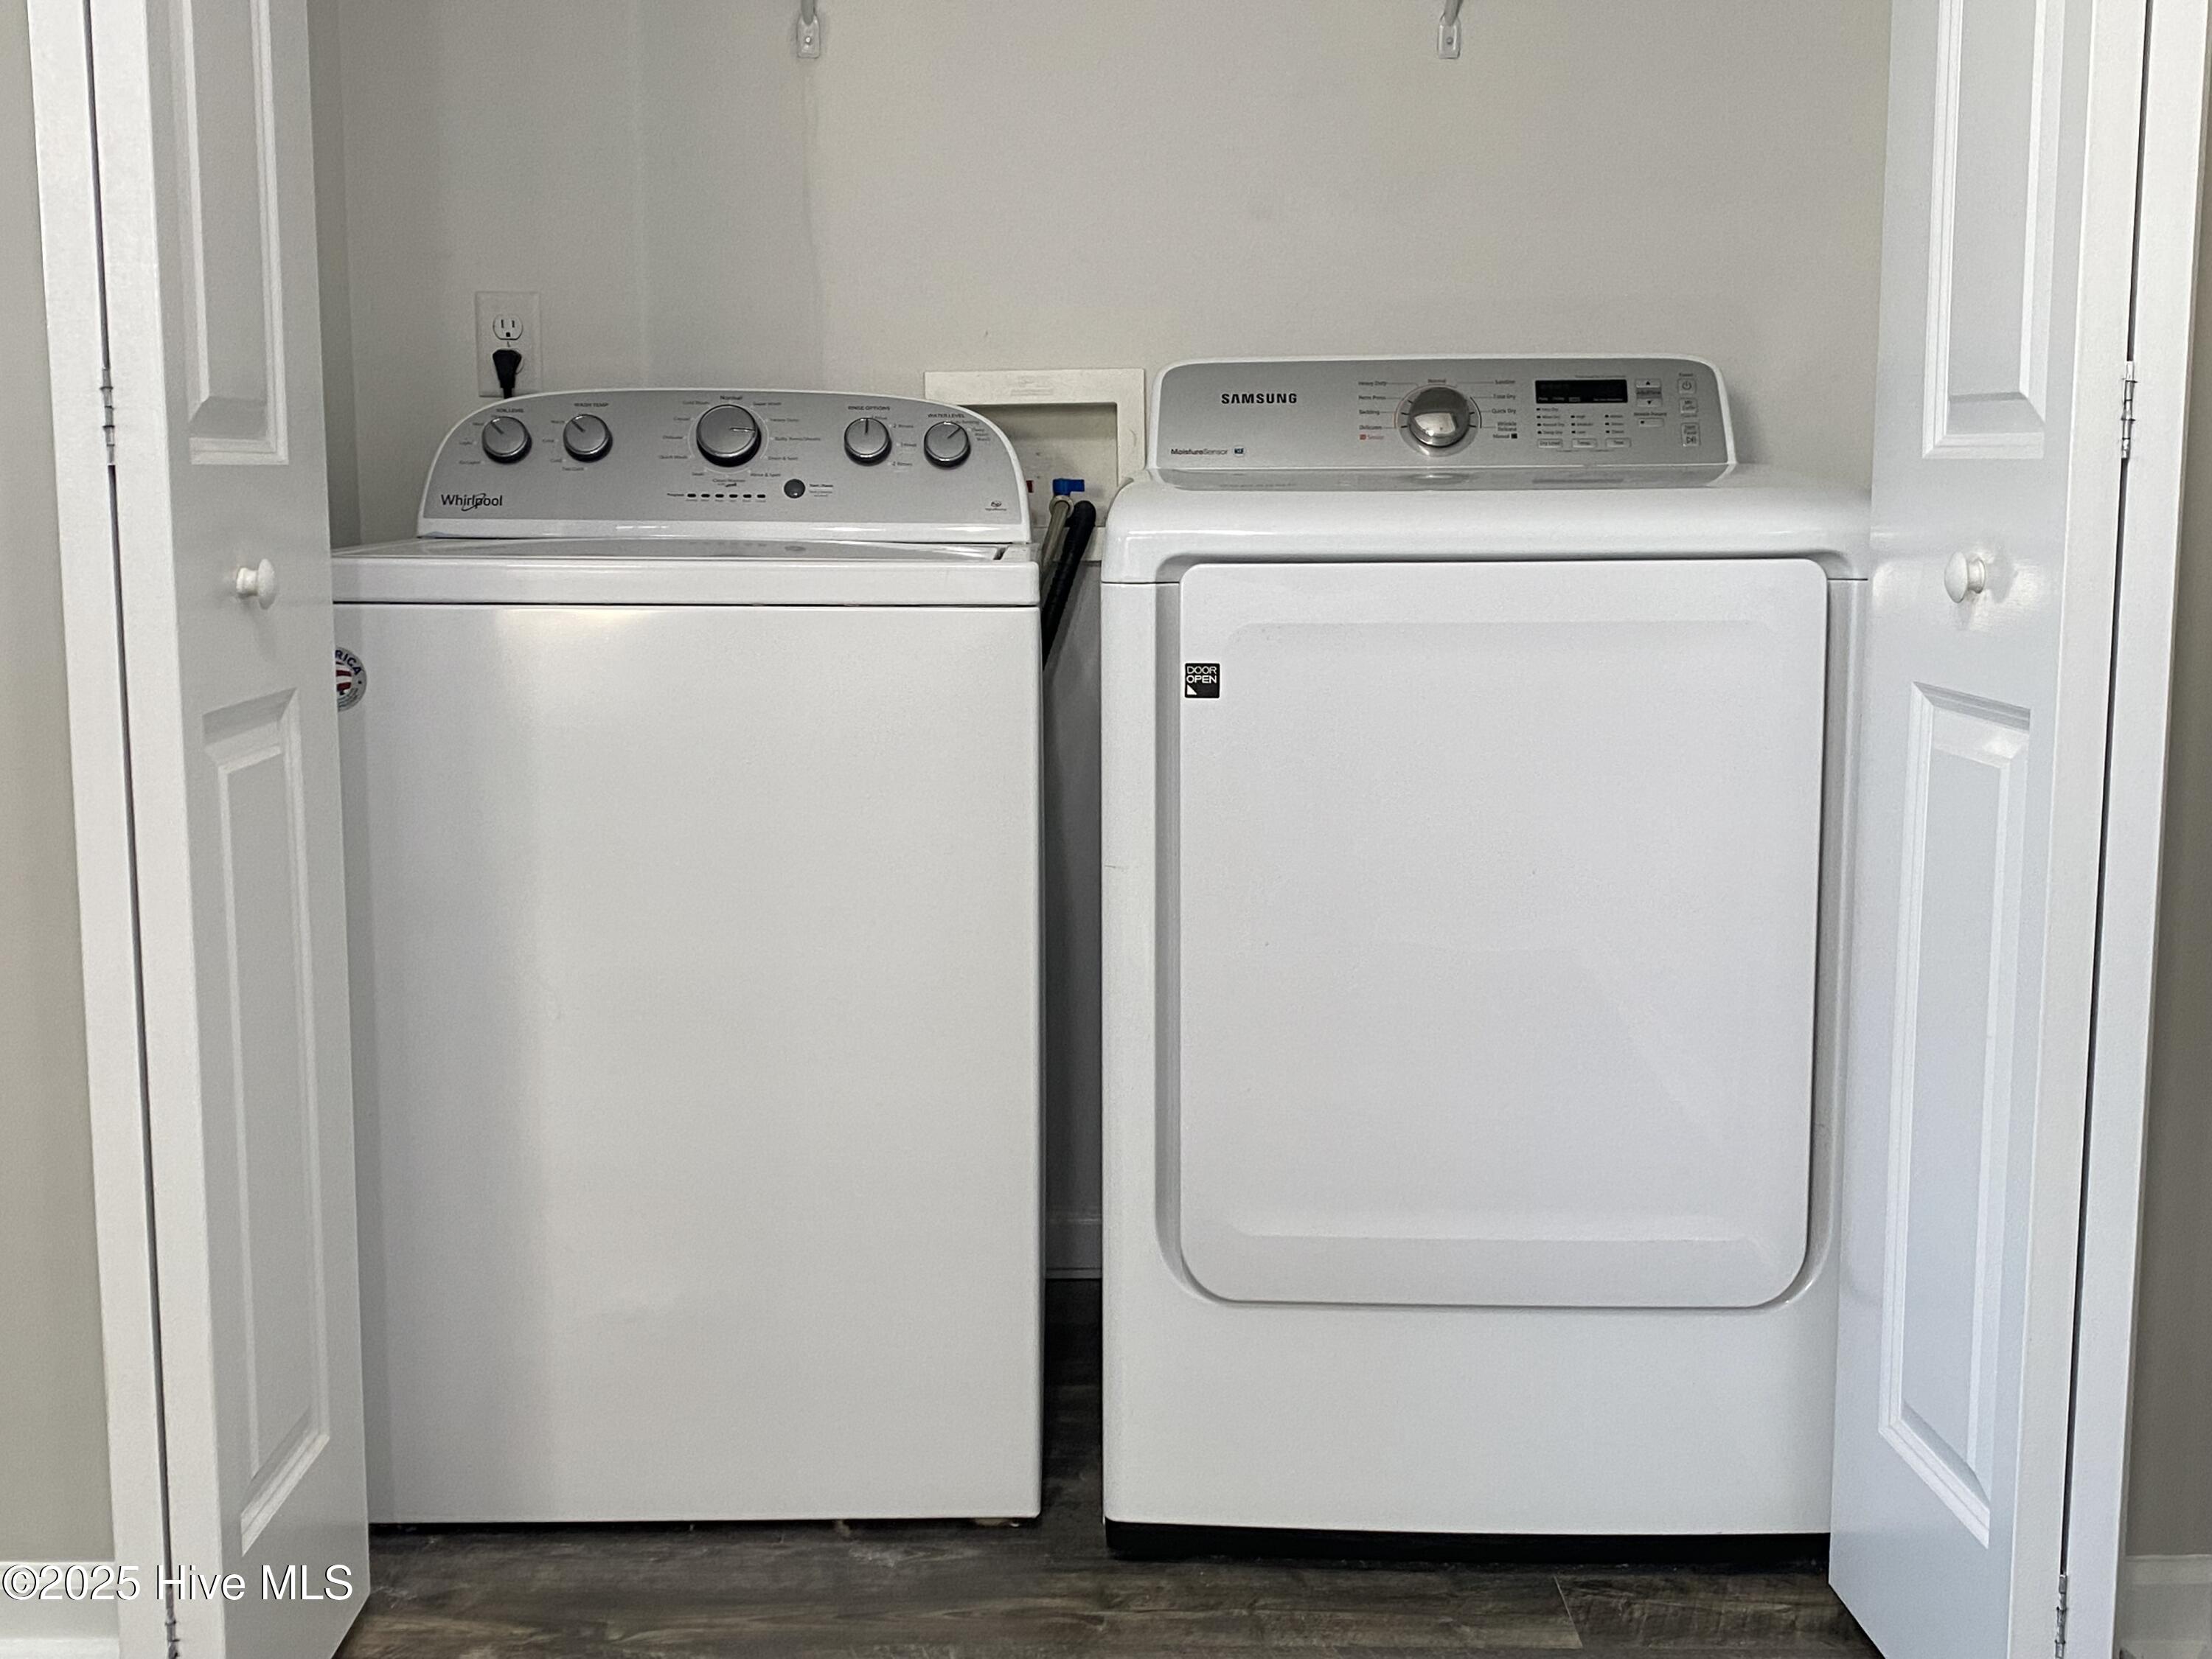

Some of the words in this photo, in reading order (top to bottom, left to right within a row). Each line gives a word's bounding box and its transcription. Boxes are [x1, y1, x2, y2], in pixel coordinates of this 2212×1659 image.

[1221, 393, 1298, 404] SAMSUNG
[441, 493, 503, 512] Whirlpool
[1187, 666, 1217, 674] DOOR
[1186, 675, 1217, 684] OPEN
